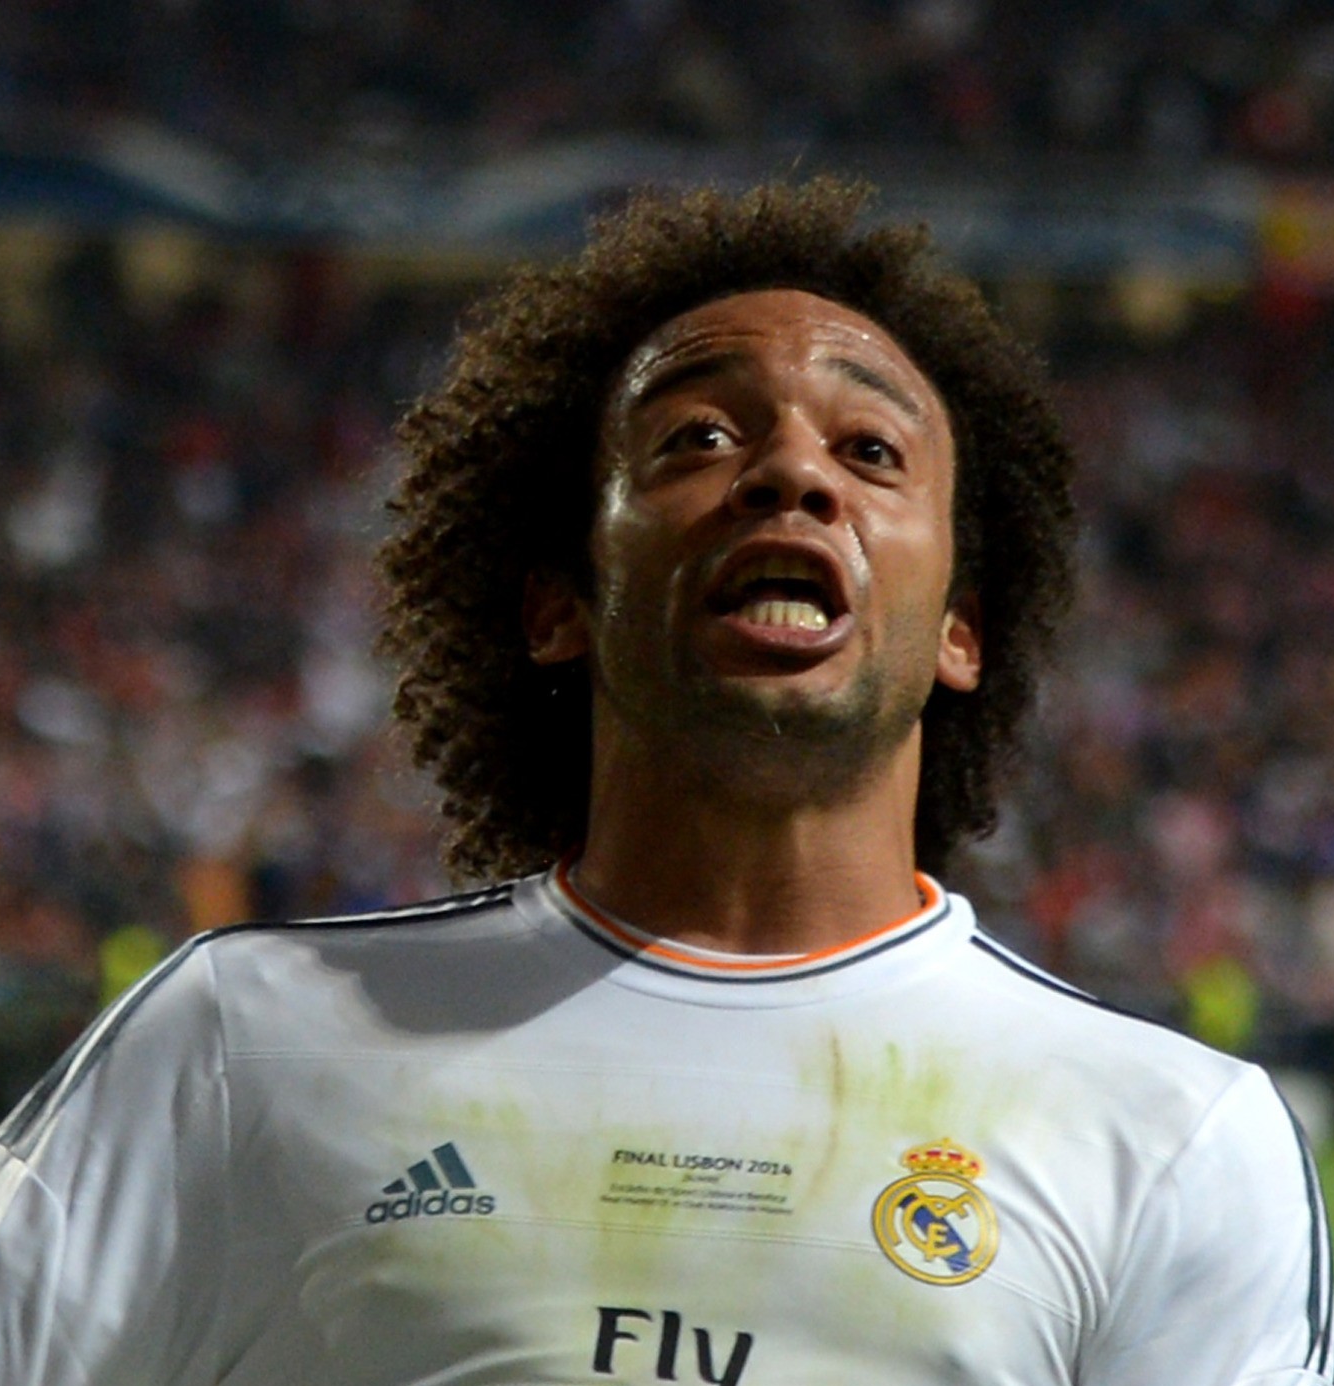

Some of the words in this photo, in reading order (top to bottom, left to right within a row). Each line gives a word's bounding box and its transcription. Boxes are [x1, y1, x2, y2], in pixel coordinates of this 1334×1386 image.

[613, 1150, 667, 1167] FINAL
[674, 1154, 742, 1170] LISBON
[748, 1160, 792, 1176] 2014
[365, 1189, 496, 1224] adidas
